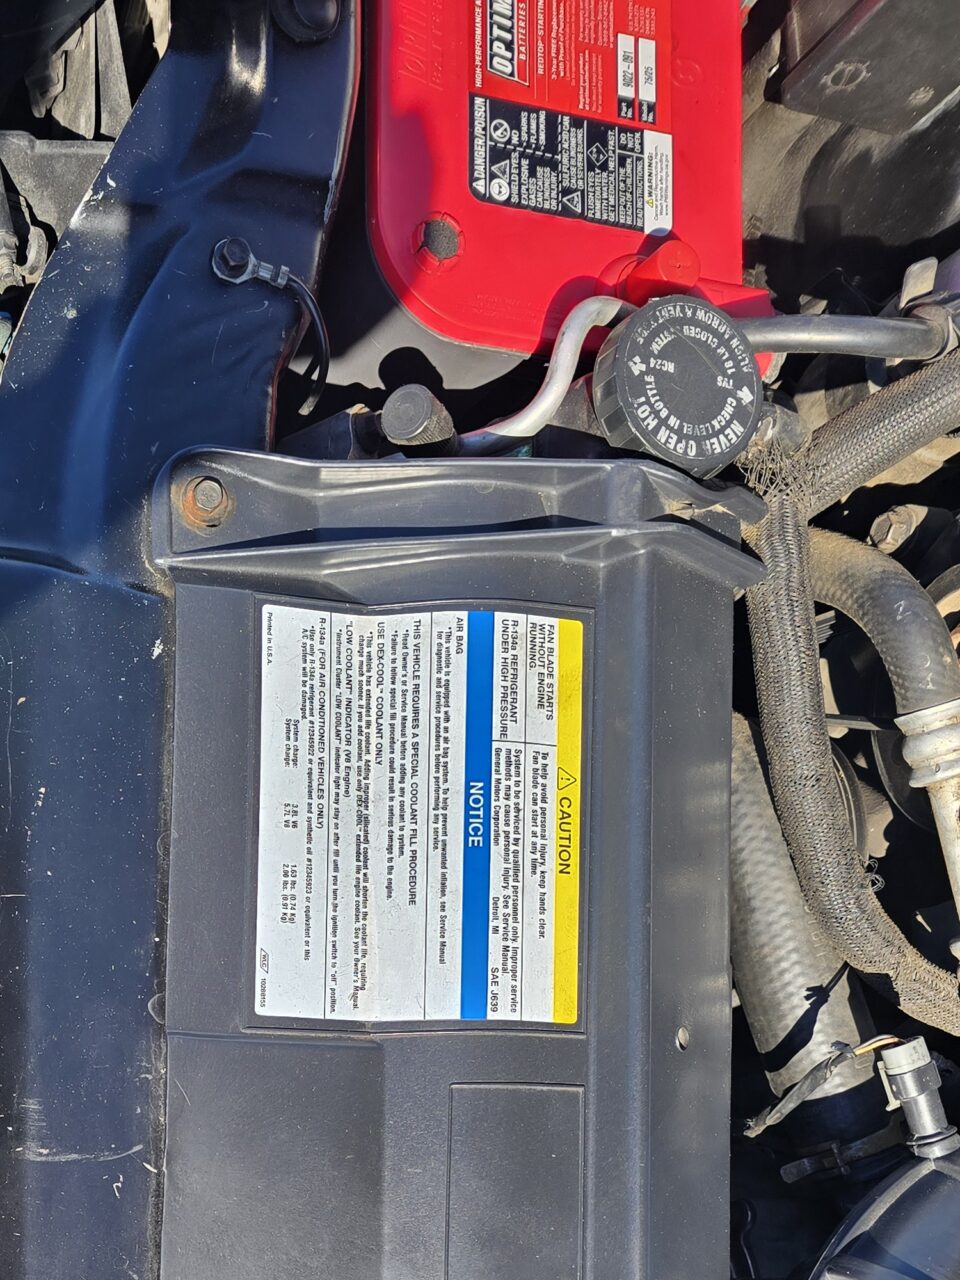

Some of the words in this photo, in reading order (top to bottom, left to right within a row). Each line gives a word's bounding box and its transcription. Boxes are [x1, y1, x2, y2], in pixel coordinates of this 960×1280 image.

[491, 0, 513, 76] OPTIM
[518, 3, 526, 60] BATTERIES
[474, 97, 485, 180] DANGER/POISON
[511, 130, 519, 144] NO
[620, 133, 627, 145] DO
[511, 151, 519, 174] EYES.
[510, 174, 519, 203] SHIELD
[521, 158, 529, 205] EXPLOSIVE
[656, 305, 682, 326] VENT
[685, 306, 693, 317] &
[696, 309, 732, 339] ARROW
[649, 357, 675, 373] RC24
[717, 376, 734, 390] TVS
[644, 375, 669, 418] BOTTLE
[667, 415, 680, 429] IN
[712, 397, 736, 431] CHECK
[657, 426, 696, 456] OPEN
[683, 423, 712, 435] LEVEL
[700, 420, 744, 455] NEVER
[377, 622, 385, 640] USE
[413, 619, 421, 640] THIS
[456, 617, 464, 632] AIR
[501, 619, 510, 654] UNDER
[510, 620, 519, 651] R-134a
[547, 624, 555, 644] FAN
[455, 635, 464, 655] BAG
[529, 622, 537, 671] RUNNING.
[537, 623, 546, 669] WITHOUT
[317, 648, 326, 670] (FOR
[412, 642, 421, 681] VEHICLE
[501, 657, 509, 682] HIGH
[546, 647, 555, 679] BLADE
[318, 672, 326, 688] AIR
[509, 654, 518, 724] REFRIGERANT
[537, 672, 545, 710] ENGINE
[411, 683, 420, 730] REQUIRES
[499, 685, 509, 739] PRESSURE
[545, 682, 554, 721] STARTS
[318, 690, 326, 754] CONDITIONED
[344, 697, 353, 747] INDICATOR
[375, 696, 384, 740] COOLANT
[343, 749, 352, 763] (V8
[375, 742, 383, 766] ONLY
[410, 741, 420, 780] SPECIAL
[494, 747, 503, 775] General
[504, 748, 513, 782] methods
[512, 748, 523, 778] System
[532, 750, 540, 765] Fan
[541, 752, 549, 761] To
[317, 756, 325, 800] VEHICLES
[342, 765, 352, 798] Engine)
[514, 780, 522, 788] to
[532, 767, 540, 789] blade
[539, 763, 549, 780] help
[493, 778, 502, 802] Motors
[502, 784, 511, 802] may
[513, 790, 522, 800] be
[540, 782, 549, 804] avoid
[315, 803, 324, 829] ONLY)
[409, 782, 419, 826] COOLANT
[468, 782, 484, 847] NOTICE
[503, 804, 511, 827] cause
[492, 805, 502, 846] Corporation
[513, 802, 522, 835] serviced
[531, 809, 539, 828] start
[539, 806, 548, 841] personal
[409, 828, 418, 847] FILL
[511, 837, 521, 847] by
[531, 830, 539, 838] at
[558, 796, 572, 875] CAUTION
[502, 830, 511, 865] personal
[529, 841, 538, 855] any
[537, 843, 548, 867] injury,
[408, 849, 418, 906] PROCEDURE
[501, 867, 512, 890] injury.
[511, 849, 521, 883] qualified
[530, 858, 539, 877] time.
[537, 870, 548, 889] keep
[491, 896, 500, 922] Detroit,
[502, 894, 511, 909] See
[510, 885, 520, 924] personnel
[539, 892, 547, 915] hands
[492, 925, 500, 935] MI
[502, 912, 511, 942] Service
[510, 926, 519, 943] only.
[538, 918, 547, 938] clear.
[501, 944, 511, 974] Manual.
[509, 946, 519, 982] Improper
[490, 967, 500, 987] SAE
[490, 990, 499, 1013] J639
[510, 984, 519, 1013] service
